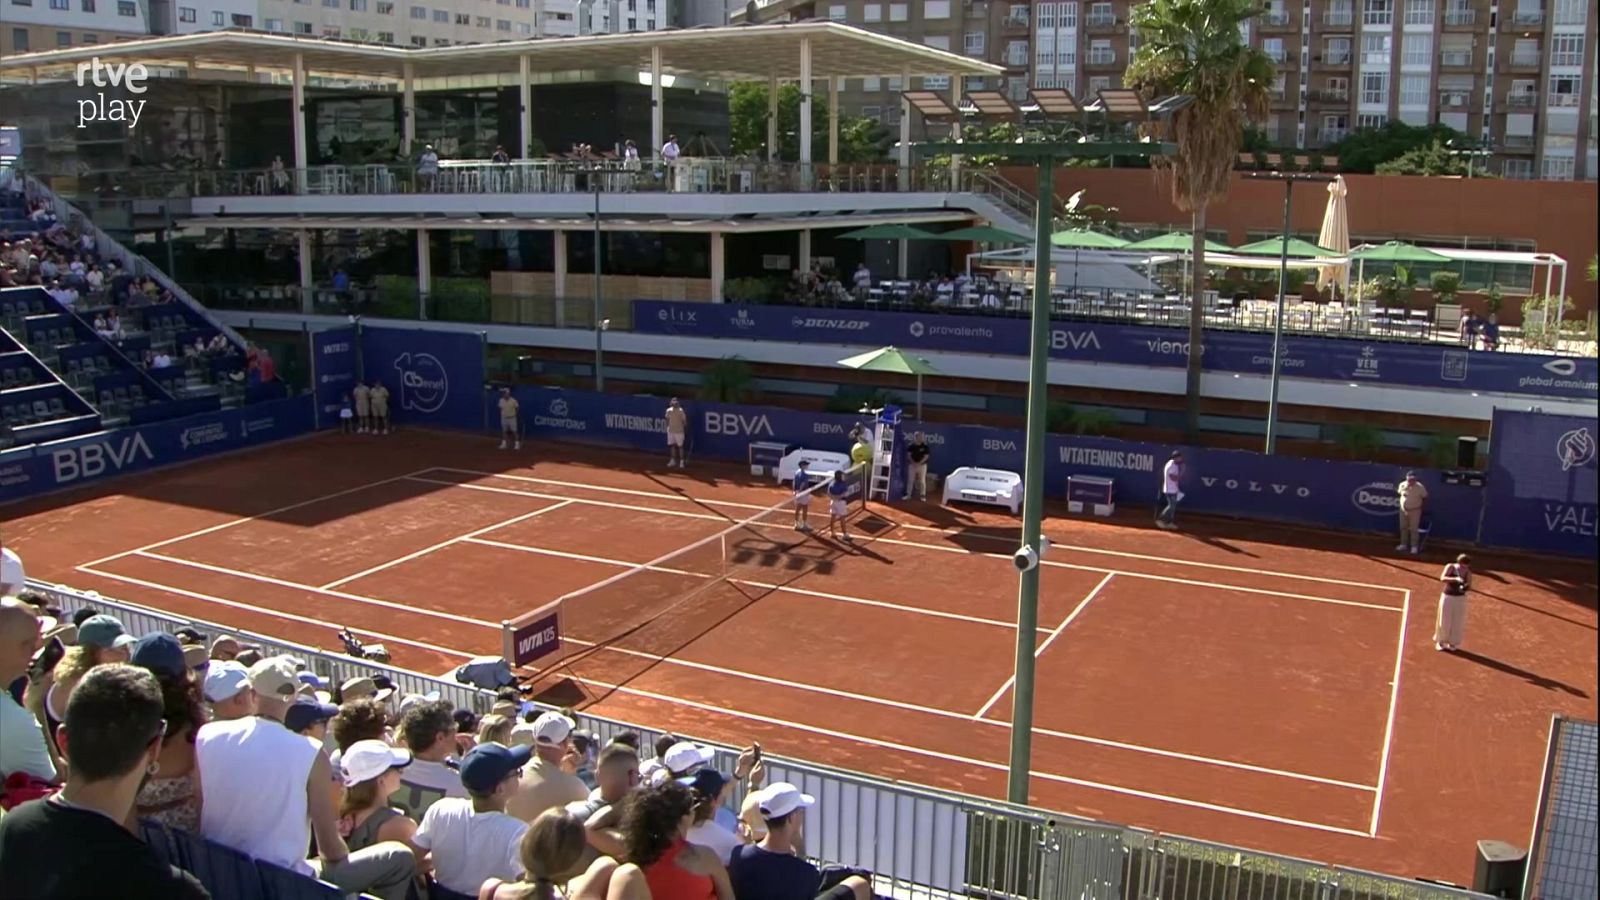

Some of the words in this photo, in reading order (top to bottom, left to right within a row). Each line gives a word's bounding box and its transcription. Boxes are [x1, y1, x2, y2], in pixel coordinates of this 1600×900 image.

[658, 307, 697, 321] elix
[804, 318, 870, 330] DUNLOP
[1048, 330, 1100, 350] BVA
[1519, 376, 1554, 387] global
[1554, 379, 1598, 391] omnium
[605, 413, 667, 433] WTATENNIS.CO
[705, 411, 775, 436] BBVA
[813, 422, 844, 434] BBVA
[983, 439, 1016, 451] BBVA
[52, 431, 154, 483] BBVA
[1060, 446, 1154, 472] WTATENNIS.COM
[1200, 476, 1310, 497] VOLVO
